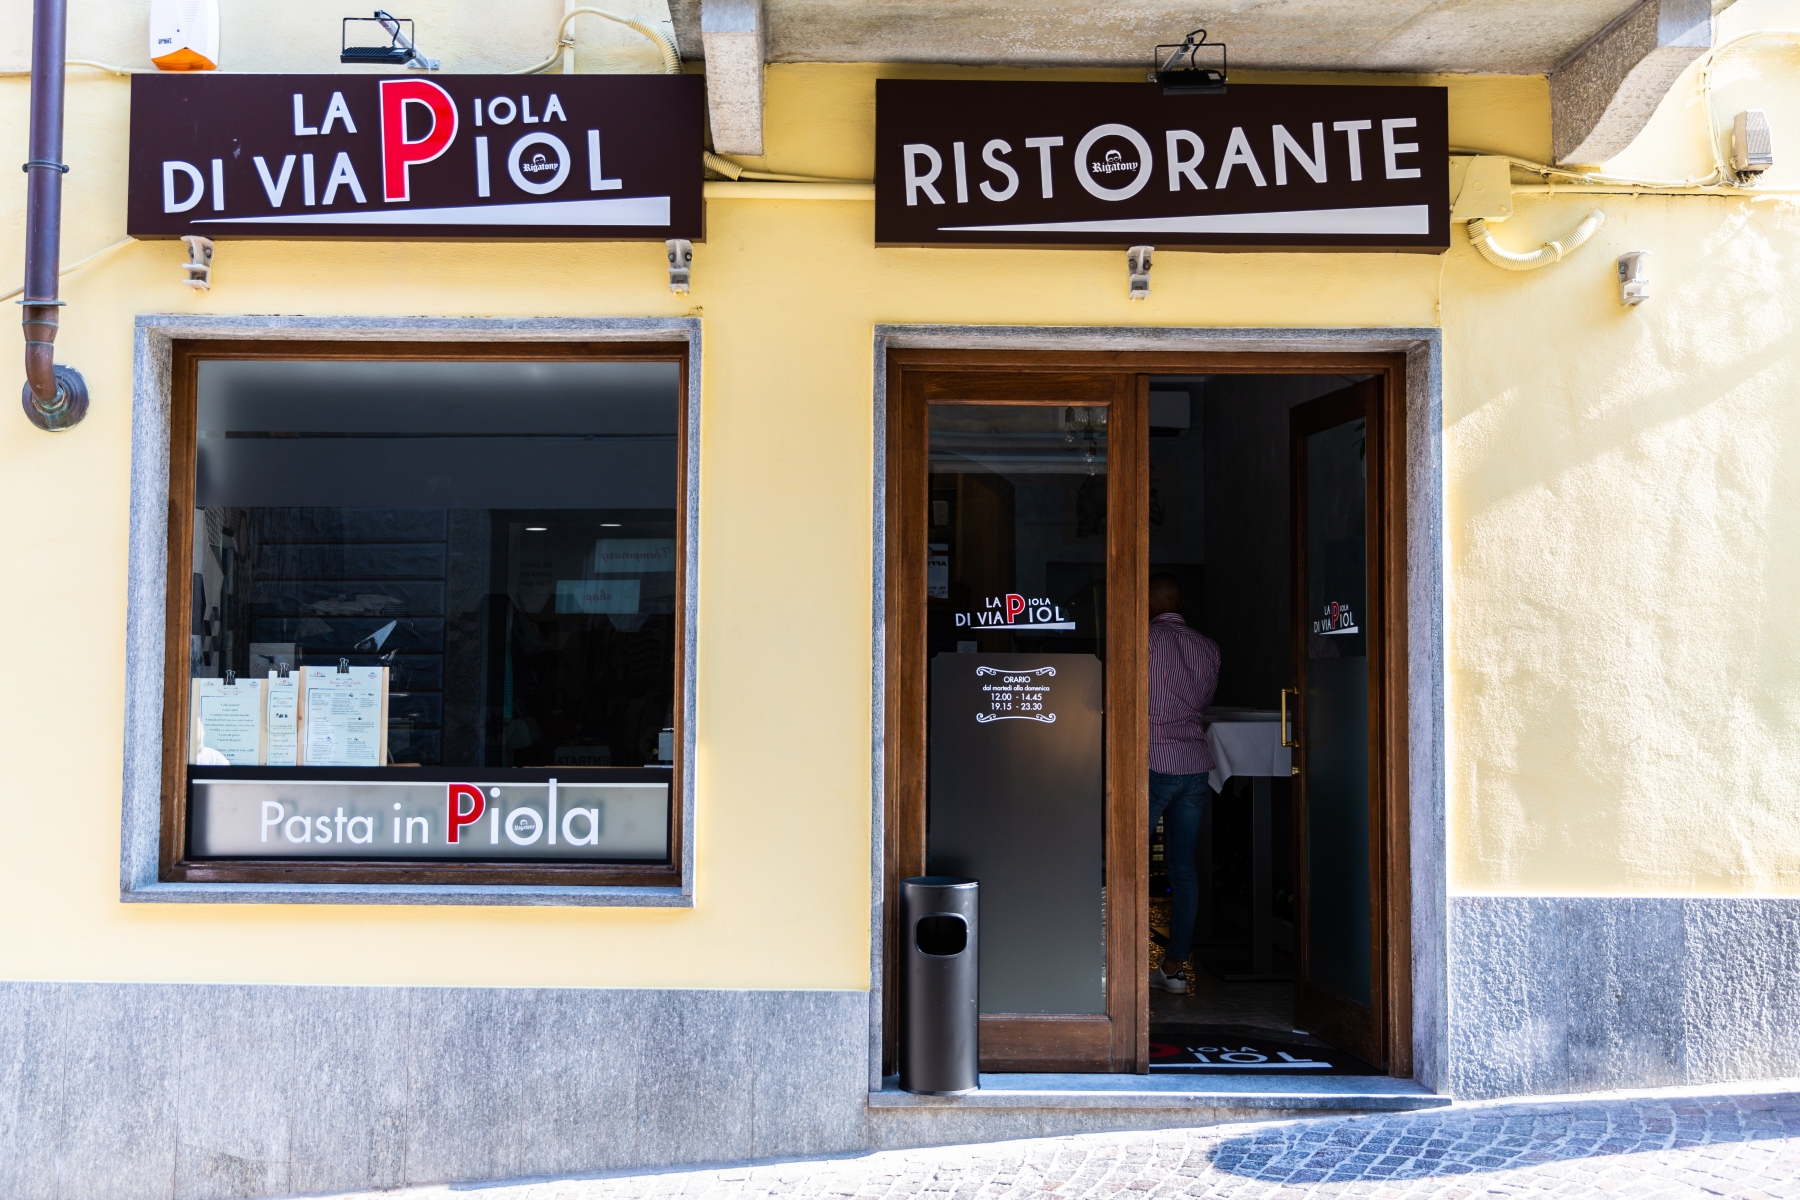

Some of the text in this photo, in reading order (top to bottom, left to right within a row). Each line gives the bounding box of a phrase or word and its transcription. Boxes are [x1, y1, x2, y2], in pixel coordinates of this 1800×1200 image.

[293, 92, 357, 136] LA
[522, 162, 559, 173] Rigatony
[903, 117, 1421, 206] RISTORANTE
[1091, 161, 1139, 174] Rigatony
[162, 158, 225, 214] DI
[253, 152, 367, 208] VIA
[985, 597, 1002, 608] LA
[955, 612, 971, 627] DI
[976, 611, 1005, 626] VIA
[991, 692, 1012, 701] 12.00
[1021, 692, 1043, 701] 14.45
[991, 702, 1012, 711] 19.15
[1020, 702, 1043, 711] 23.30
[260, 778, 600, 846] Pasta in Piola
